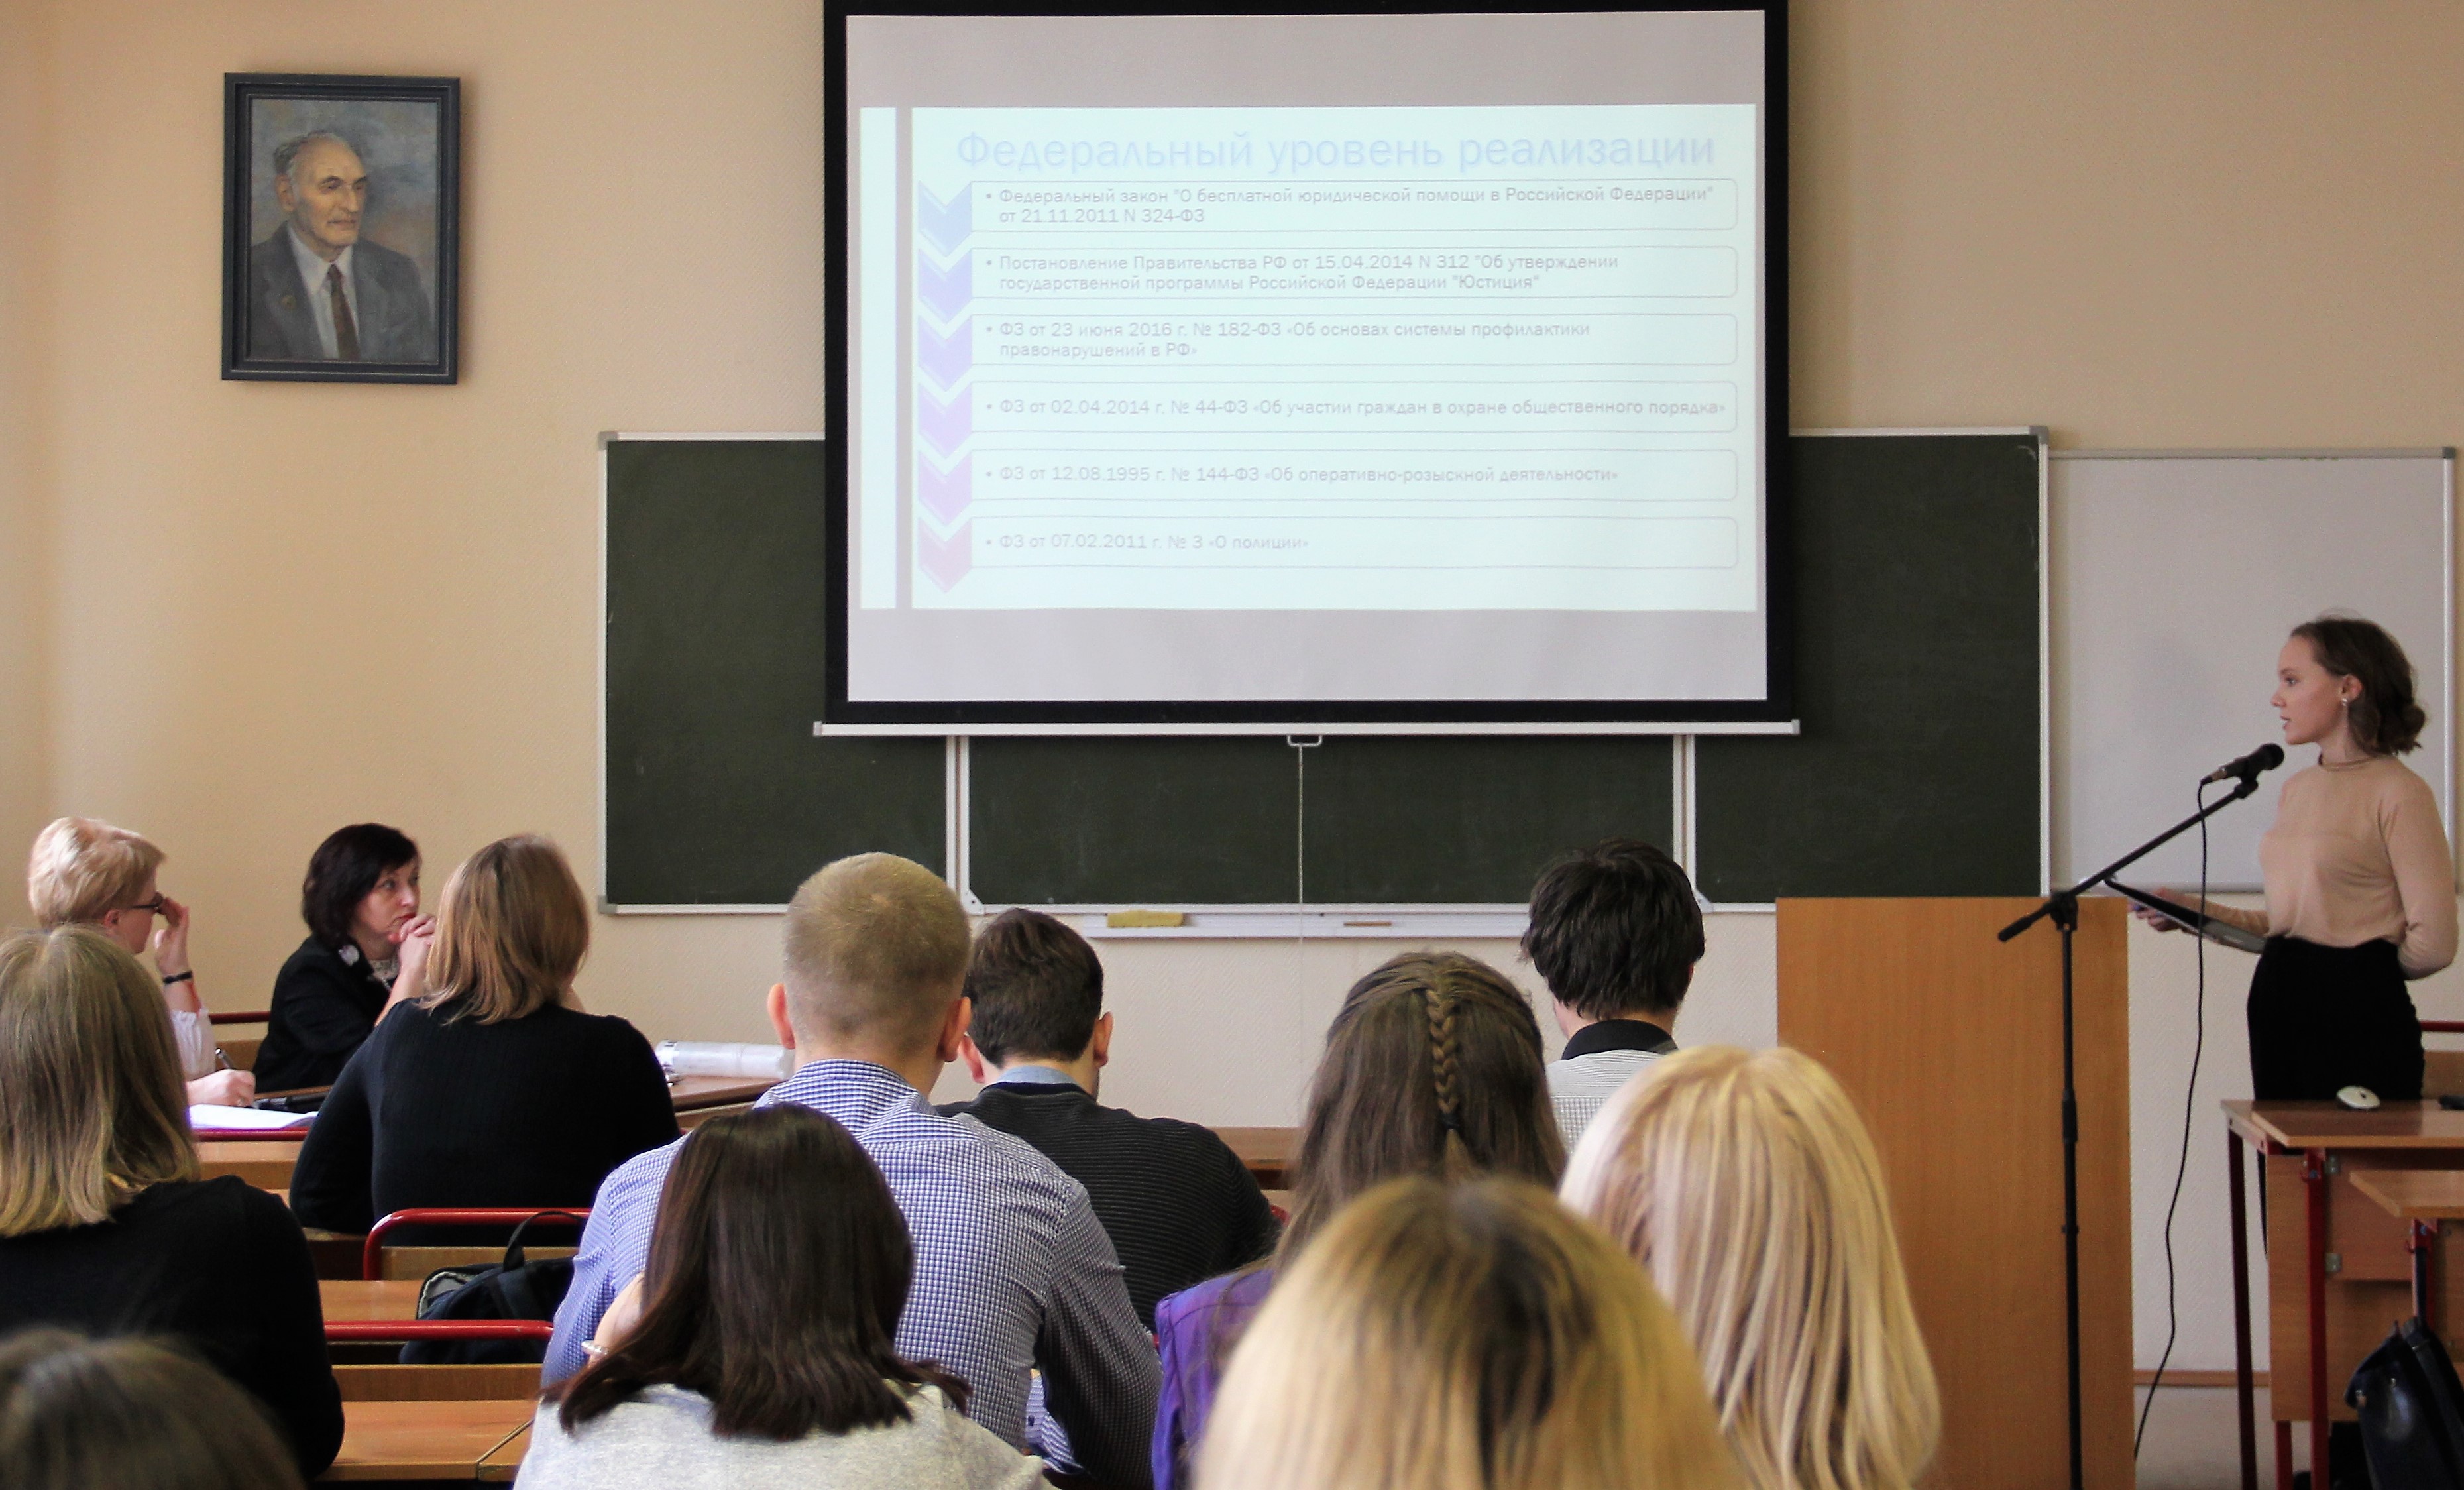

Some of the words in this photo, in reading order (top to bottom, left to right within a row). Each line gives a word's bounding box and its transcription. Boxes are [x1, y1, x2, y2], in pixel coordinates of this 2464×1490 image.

[958, 131, 1251, 174] Федеральный
[1268, 139, 1443, 174] уровень
[1459, 138, 1714, 173] реализации
[999, 188, 1115, 205] Федеральный
[1120, 192, 1168, 203] закон
[1196, 187, 1292, 203] бесплатной
[1298, 187, 1411, 205] юридической
[1416, 190, 1485, 203] помощи
[1490, 190, 1501, 202] в
[1505, 186, 1605, 201] Российской
[999, 211, 1017, 223] от
[1021, 208, 1119, 223] 21.11.2011
[1123, 208, 1136, 223] N
[1141, 208, 1205, 223] 324-ФЗ
[999, 255, 1129, 270] Постановление
[1133, 255, 1257, 272] Правительства
[1262, 255, 1288, 270] РФ
[1292, 258, 1310, 270] от
[1315, 255, 1414, 270] 15.04.2014
[1418, 255, 1431, 268] N
[1436, 254, 1469, 269] 312
[1507, 257, 1618, 272] утверждении
[999, 274, 1140, 292] государственной
[1145, 278, 1243, 292] программы
[1249, 274, 1347, 290] Российской
[1351, 275, 1447, 292] Федерации
[999, 321, 1025, 337] ФЗ
[1029, 325, 1046, 337] от
[1050, 322, 1073, 337] 23
[1078, 325, 1123, 337] июня
[1128, 321, 1173, 337] 2016
[1177, 325, 1188, 337] г.
[1192, 322, 1212, 337] №
[1217, 321, 1282, 337] 182-ФЗ
[1320, 325, 1389, 337] основах
[1393, 324, 1466, 337] системы
[1471, 322, 1590, 339] профилактики
[1000, 341, 1146, 361] правонарушений
[1150, 345, 1161, 357] в
[999, 398, 1025, 414] ФЗ
[1029, 402, 1046, 414] от
[1050, 399, 1150, 415] 02.04.2014
[1155, 402, 1165, 414] г.
[1171, 400, 1190, 414] №
[1194, 399, 1249, 414] 44-ФЗ
[1286, 402, 1352, 418] участии
[1357, 402, 1428, 417] граждан
[1432, 402, 1443, 414] в
[1447, 402, 1508, 417] охране
[1512, 398, 1644, 415] общественного
[999, 465, 1024, 481] ФЗ
[1029, 469, 1046, 481] от
[1052, 465, 1151, 482] 12.08.1995
[1156, 470, 1166, 481] г.
[1171, 467, 1190, 482] №
[1196, 467, 1260, 482] 144-ФЗ
[1298, 466, 1494, 484] оперативно-розыскной
[999, 534, 1024, 549] ФЗ
[1029, 537, 1046, 548] от
[1050, 533, 1147, 549] 07.02.2011
[1152, 537, 1162, 549] г.
[1168, 535, 1186, 549] №
[1192, 534, 1204, 549] 3
